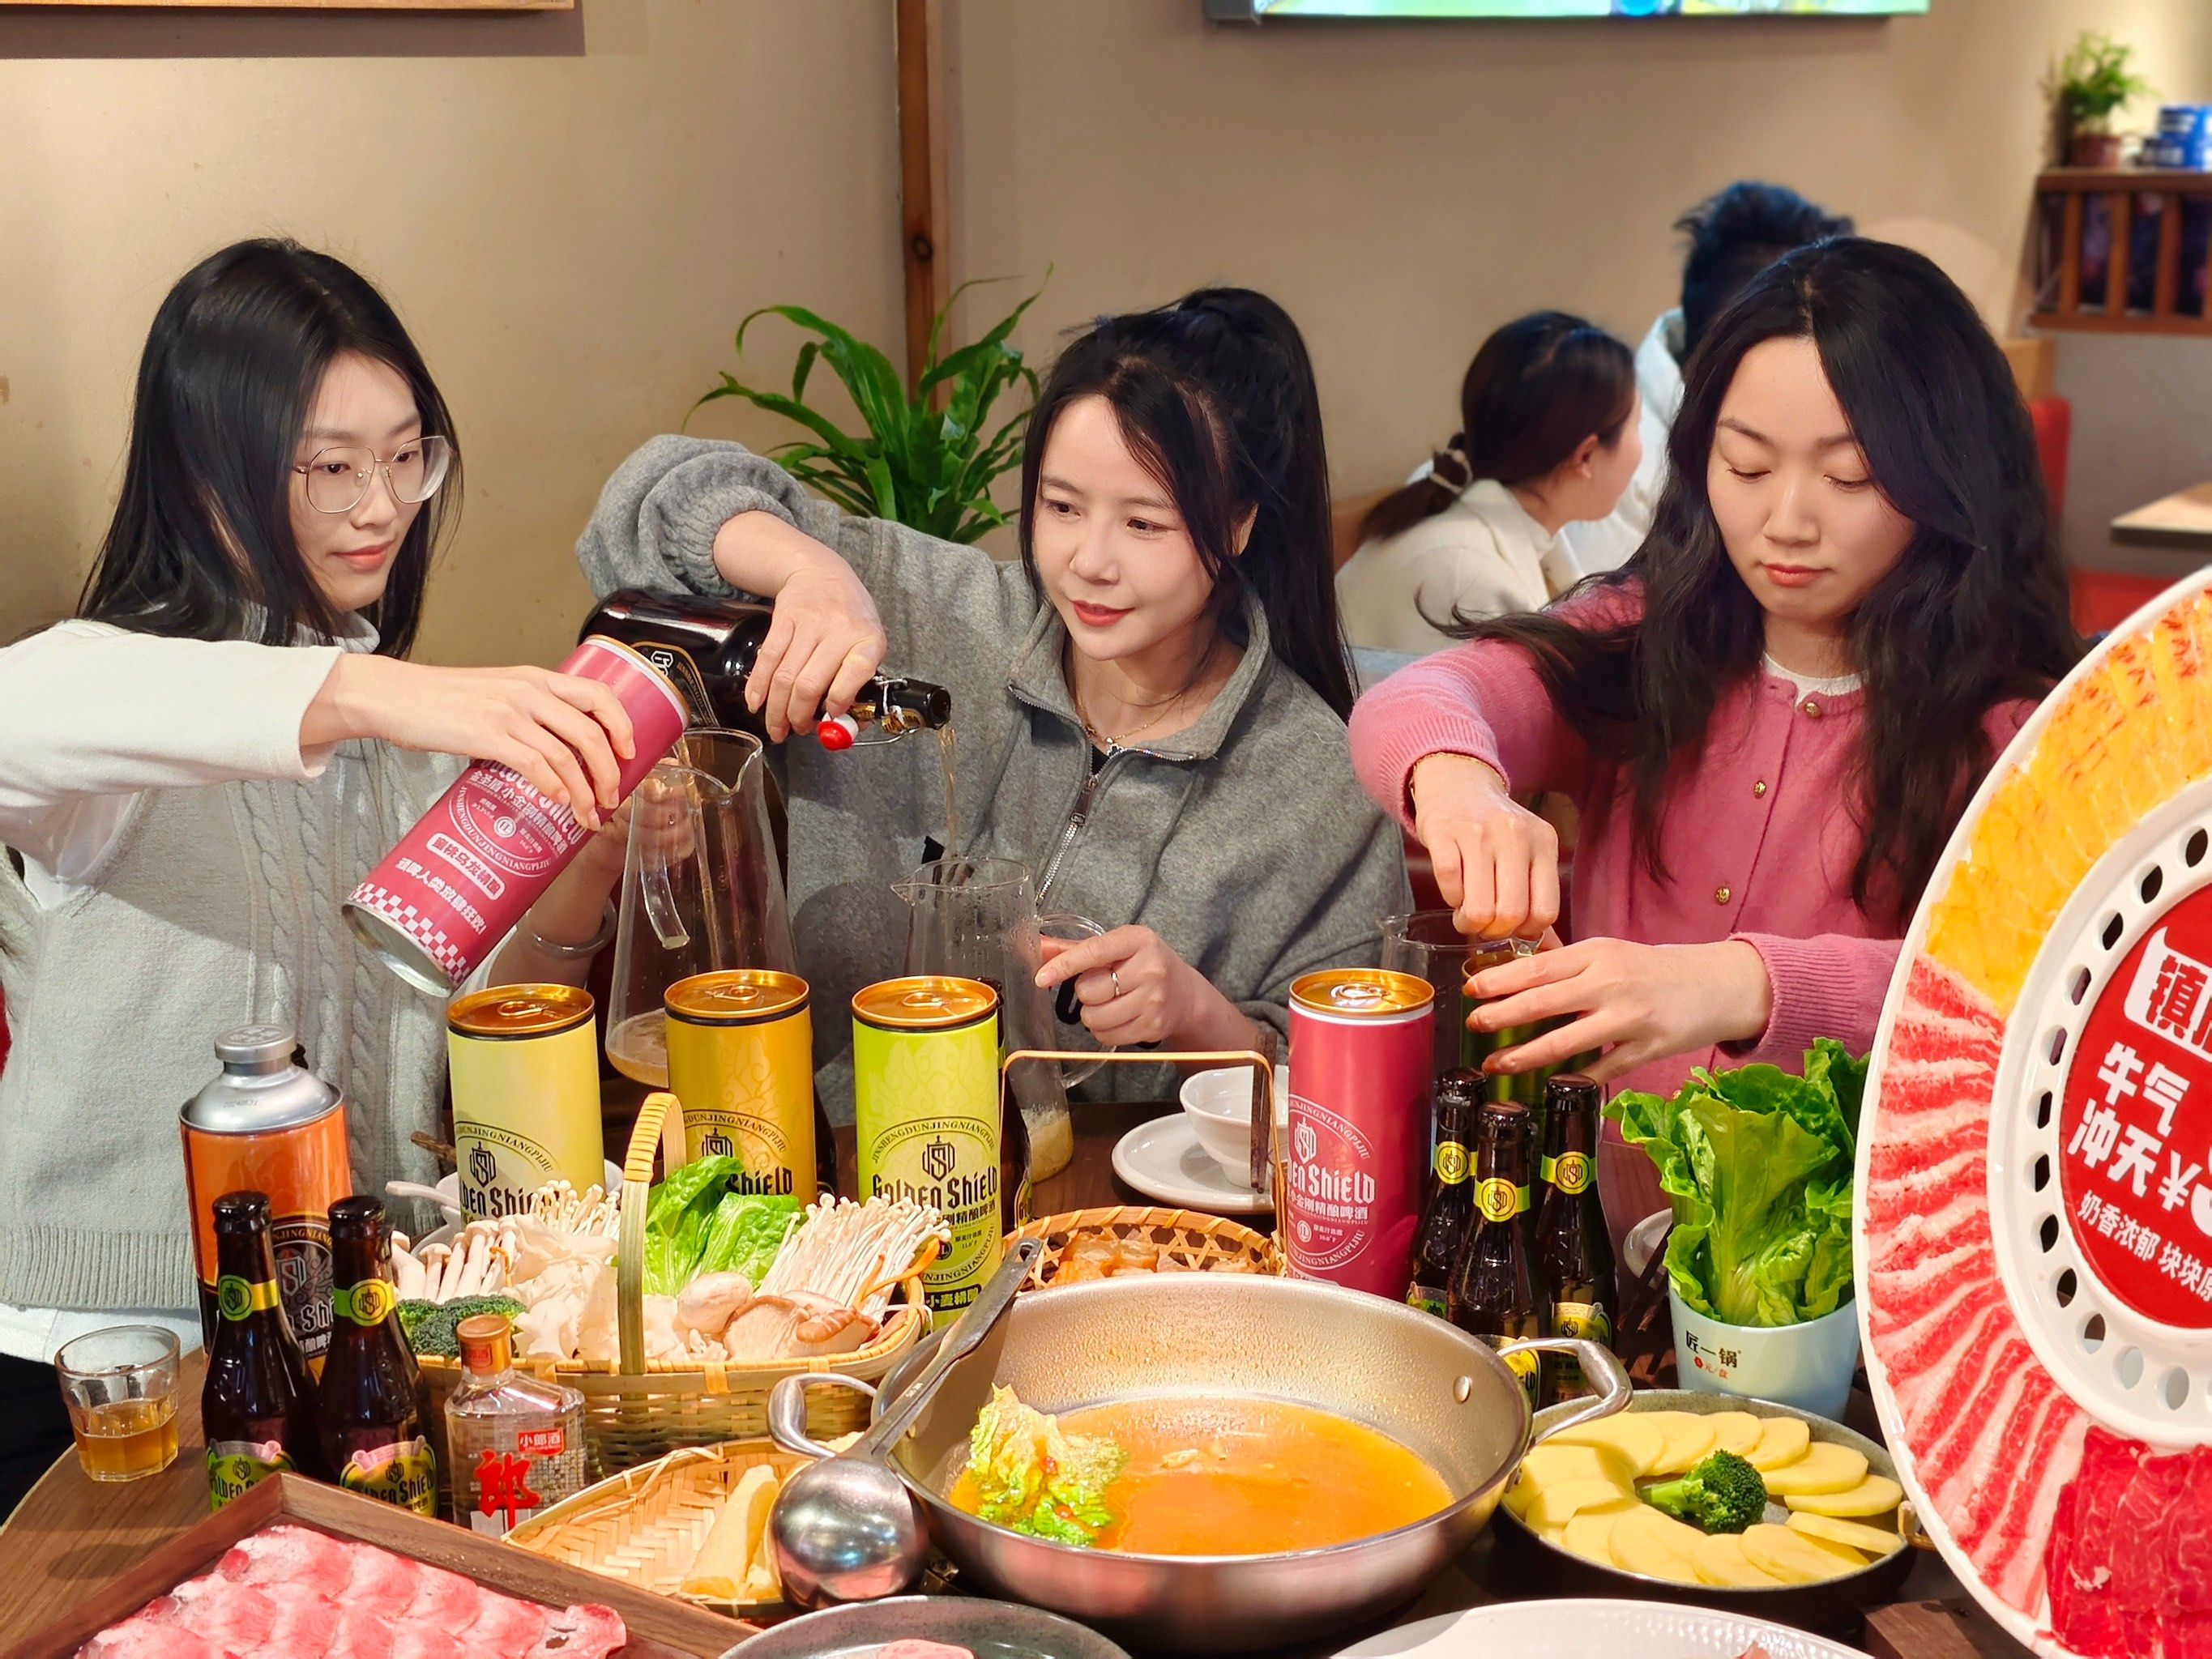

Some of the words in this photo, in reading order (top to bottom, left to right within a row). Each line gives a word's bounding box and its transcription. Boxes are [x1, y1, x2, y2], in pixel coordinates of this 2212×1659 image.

[2097, 1040, 2191, 1137] 牛气
[2067, 1098, 2163, 1198] 冲天
[946, 1165, 998, 1209] Shield
[1308, 1162, 1376, 1205] Shield
[2077, 1189, 2162, 1262] 奶香浓郁
[1685, 1329, 1738, 1368] 匠一锅
[519, 1431, 561, 1448] 小郎酒
